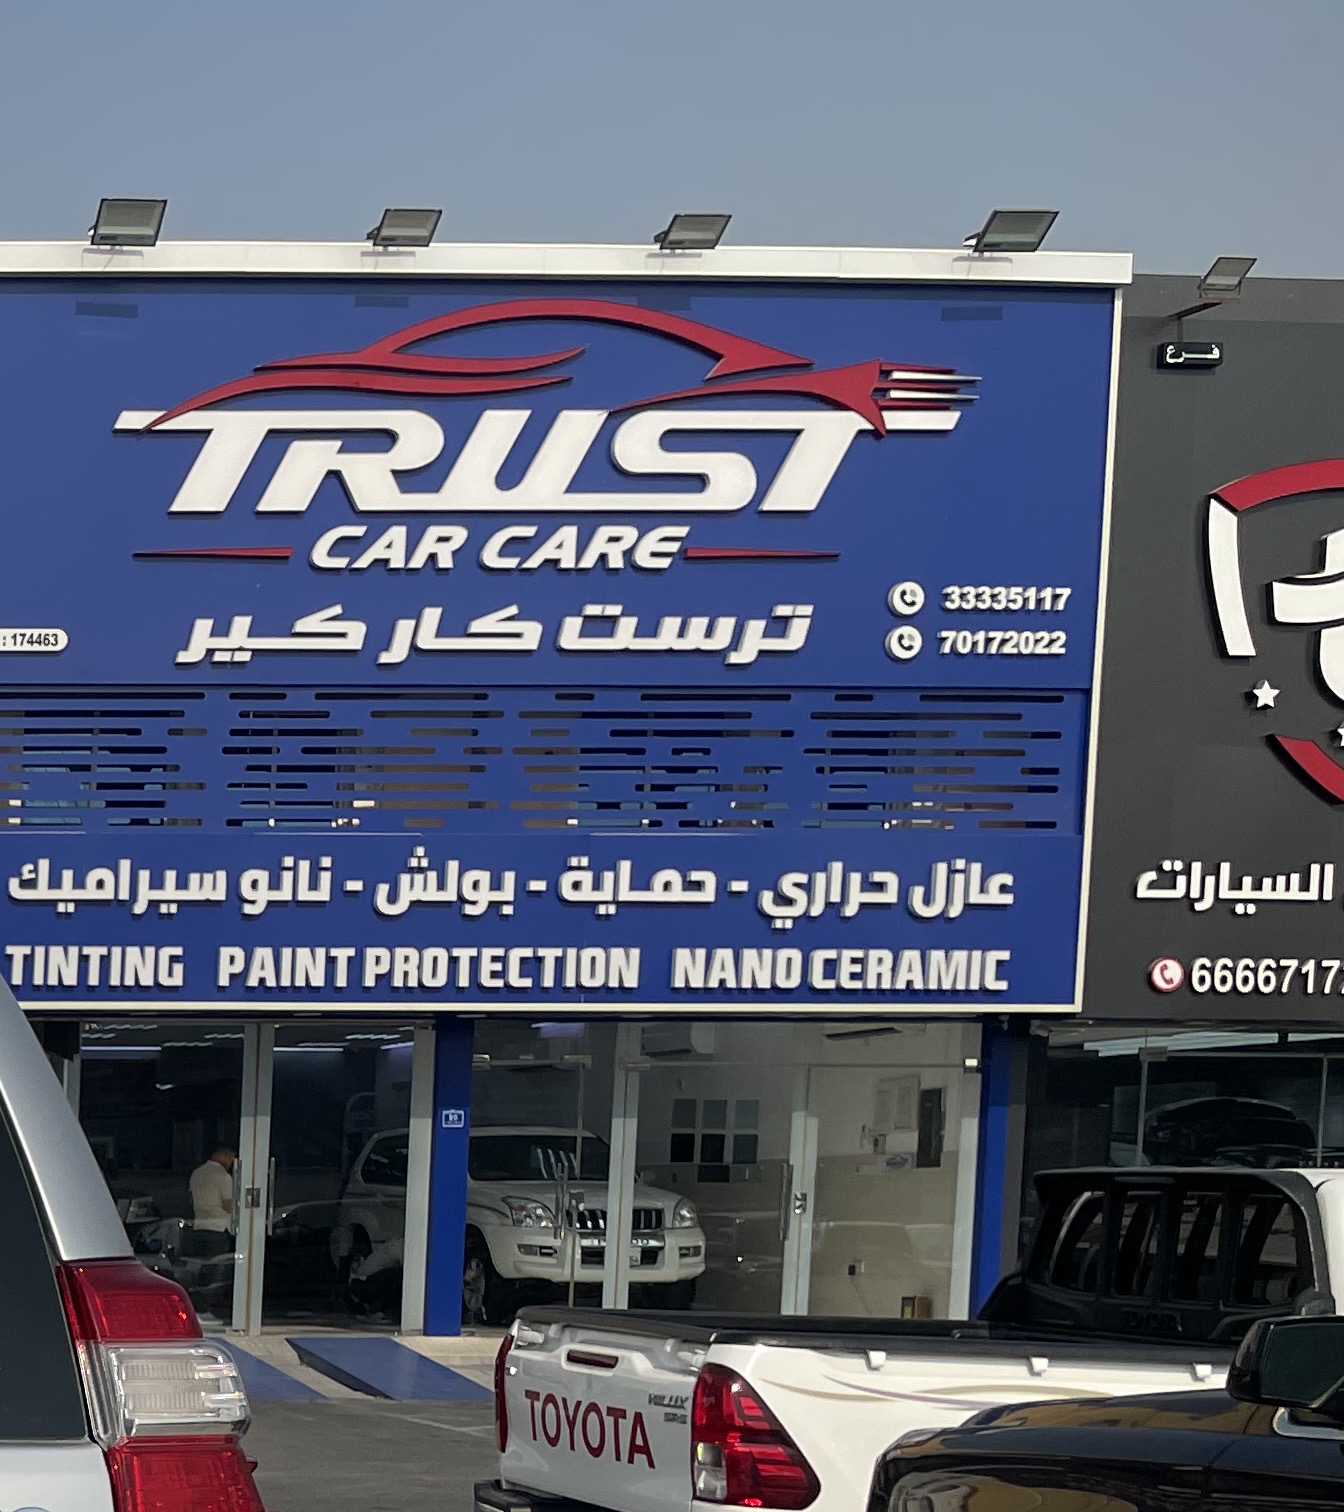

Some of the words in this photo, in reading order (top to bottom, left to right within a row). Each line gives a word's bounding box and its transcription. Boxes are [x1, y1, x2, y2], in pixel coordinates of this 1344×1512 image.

[112, 408, 962, 513] TRUST
[311, 525, 468, 569] CAR
[480, 525, 691, 569] CARE
[941, 586, 1071, 611] 33335117
[11, 633, 59, 646] 174463
[174, 604, 368, 664] كير
[376, 604, 544, 664] كار
[556, 604, 814, 665] ترست
[939, 631, 1066, 655] 70172022
[8, 857, 227, 915] سيراميك
[239, 856, 332, 916] نانو
[374, 845, 516, 917] بولش
[559, 856, 717, 916] حماية
[758, 861, 899, 929] حراري
[909, 858, 1015, 919] عازل
[1136, 859, 1335, 915] السيارات
[6, 945, 184, 987] TINTING
[218, 947, 355, 988] PAINT
[362, 947, 640, 990] PROTECTION
[671, 948, 802, 990] NANO
[810, 949, 1011, 992] CERAMIC
[524, 1389, 656, 1470] TOYOTA
